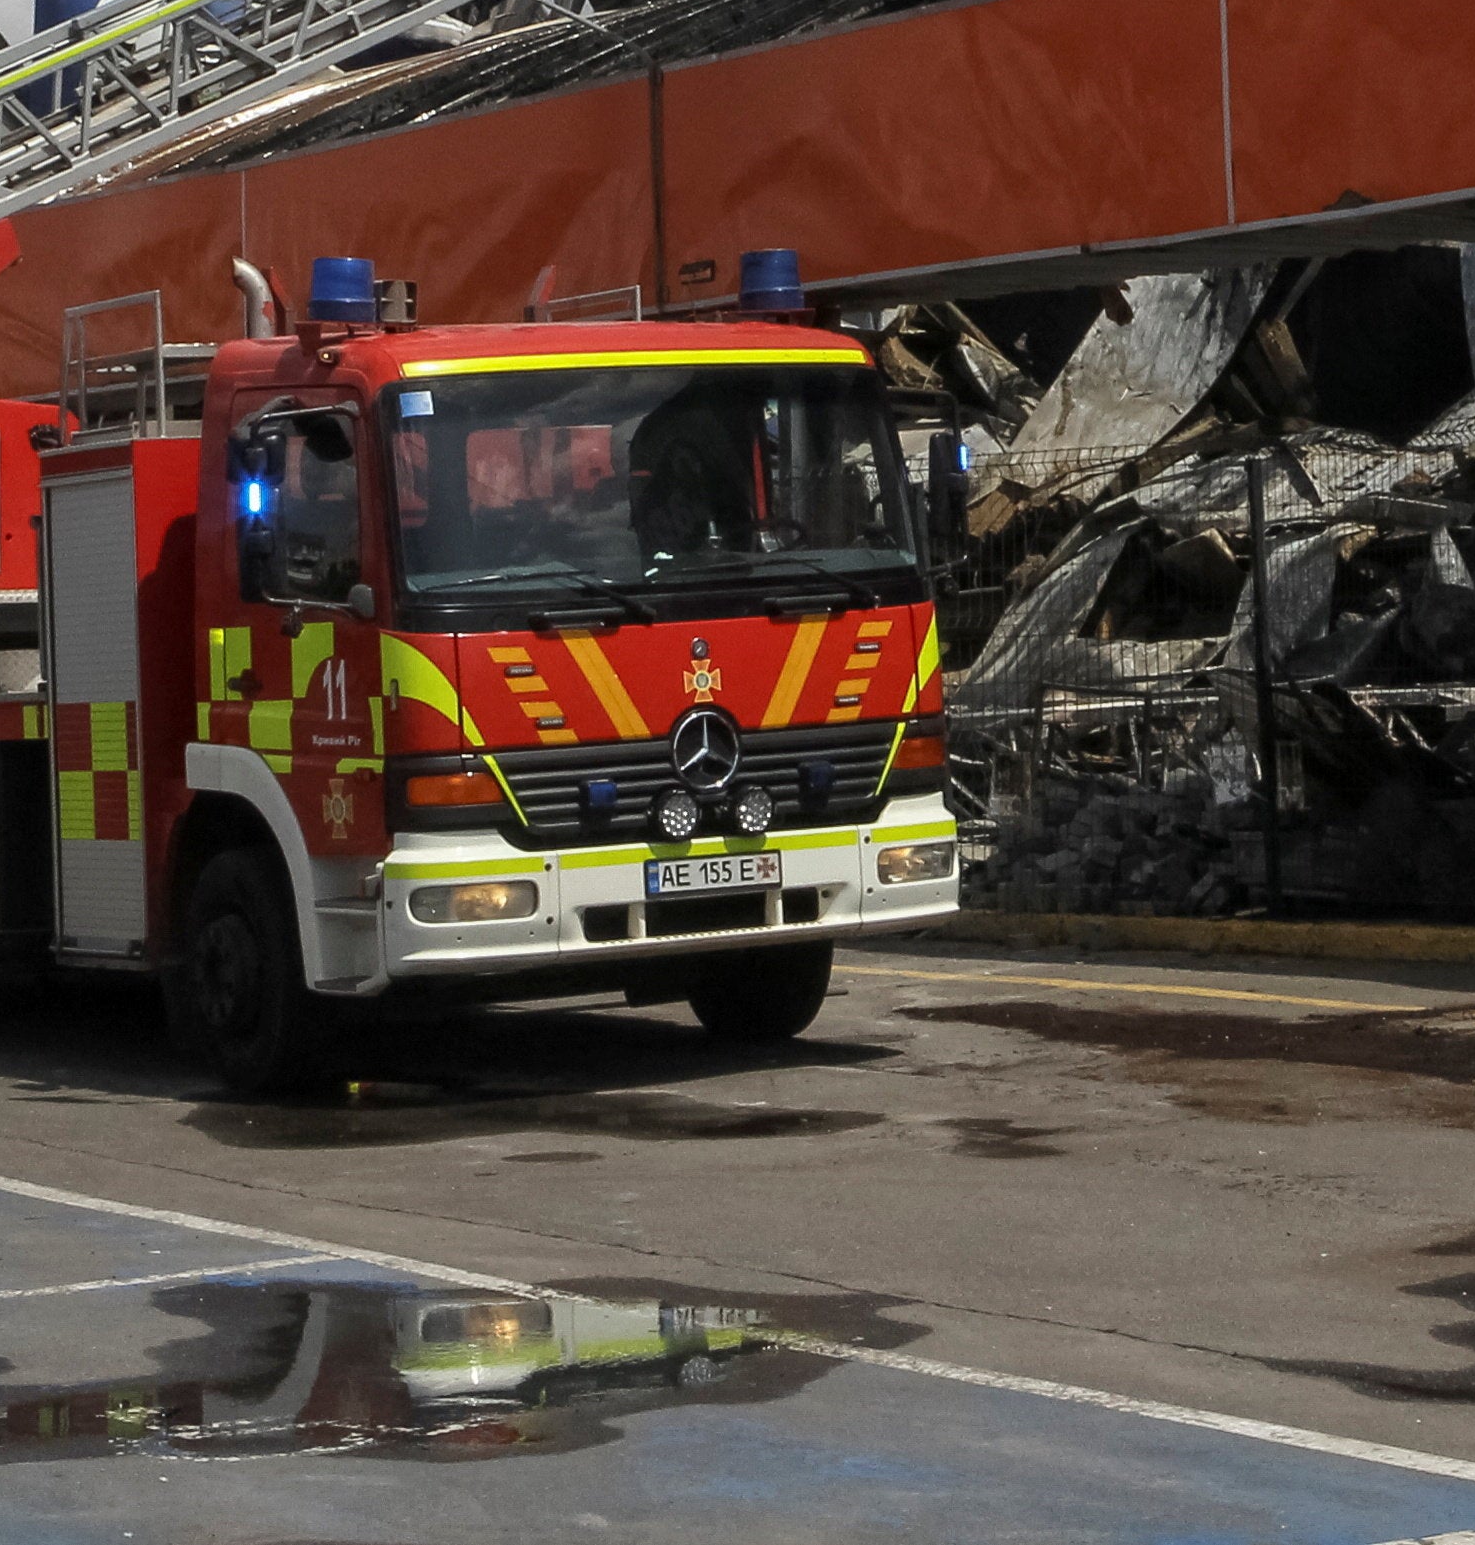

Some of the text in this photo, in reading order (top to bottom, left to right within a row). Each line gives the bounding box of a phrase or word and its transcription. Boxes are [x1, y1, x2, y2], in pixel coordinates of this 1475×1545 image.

[323, 659, 347, 720] 11
[661, 863, 691, 887] AE
[699, 860, 732, 884] 155
[740, 858, 755, 881] E
